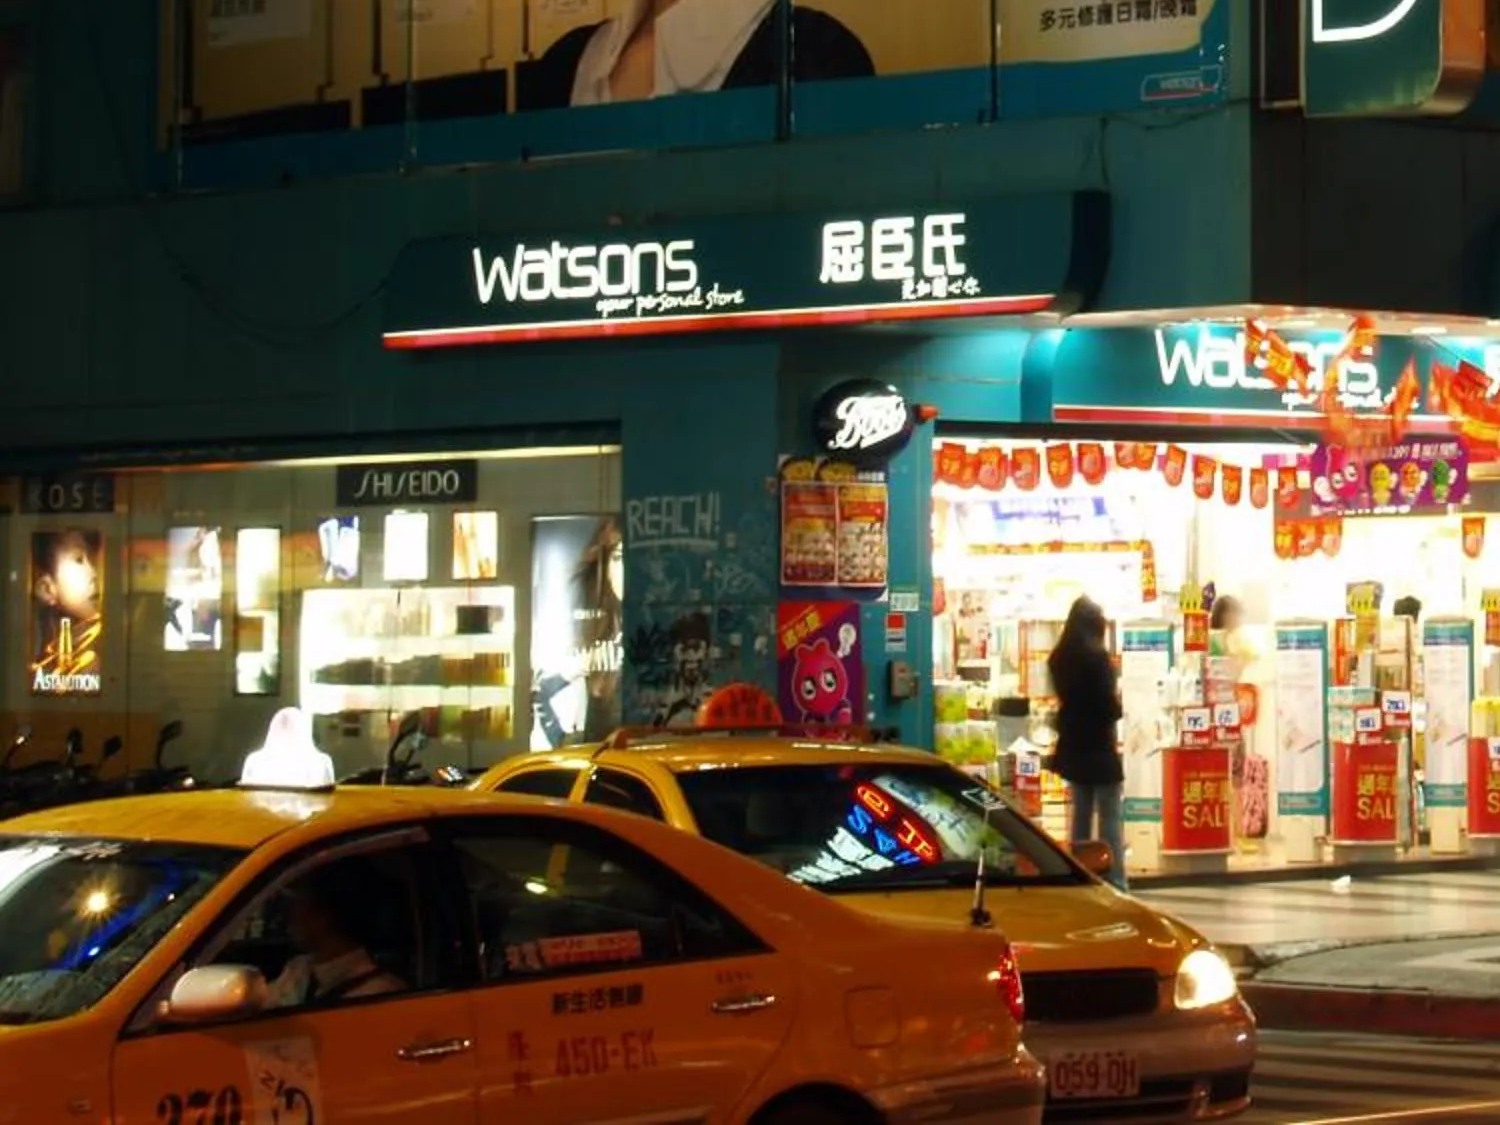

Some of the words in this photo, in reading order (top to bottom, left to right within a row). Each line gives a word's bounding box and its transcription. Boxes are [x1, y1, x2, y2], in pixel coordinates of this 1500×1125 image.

[820, 213, 967, 284] 屈臣氏
[636, 286, 702, 318] personal
[705, 282, 745, 308] store
[353, 469, 460, 498] SHISEIDO
[626, 490, 721, 539] REACH!
